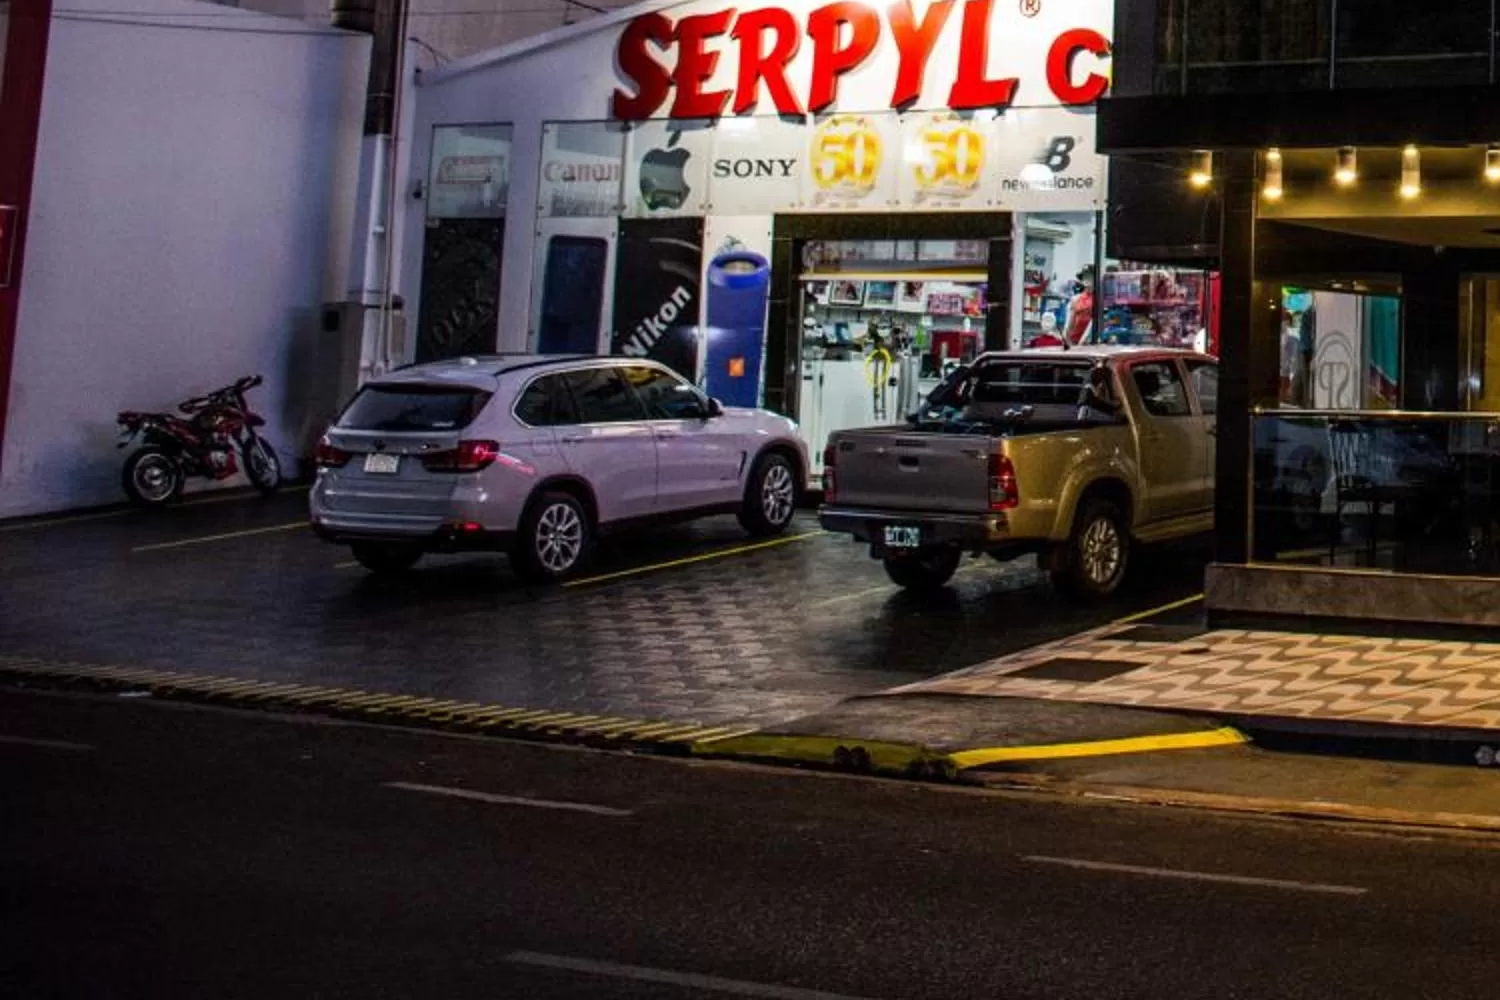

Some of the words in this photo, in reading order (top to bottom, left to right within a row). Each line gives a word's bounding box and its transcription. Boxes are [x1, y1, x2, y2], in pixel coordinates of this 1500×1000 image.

[543, 160, 620, 182] Canon
[713, 159, 796, 178] SONY
[816, 132, 876, 189] 50
[622, 285, 692, 356] Nikon
